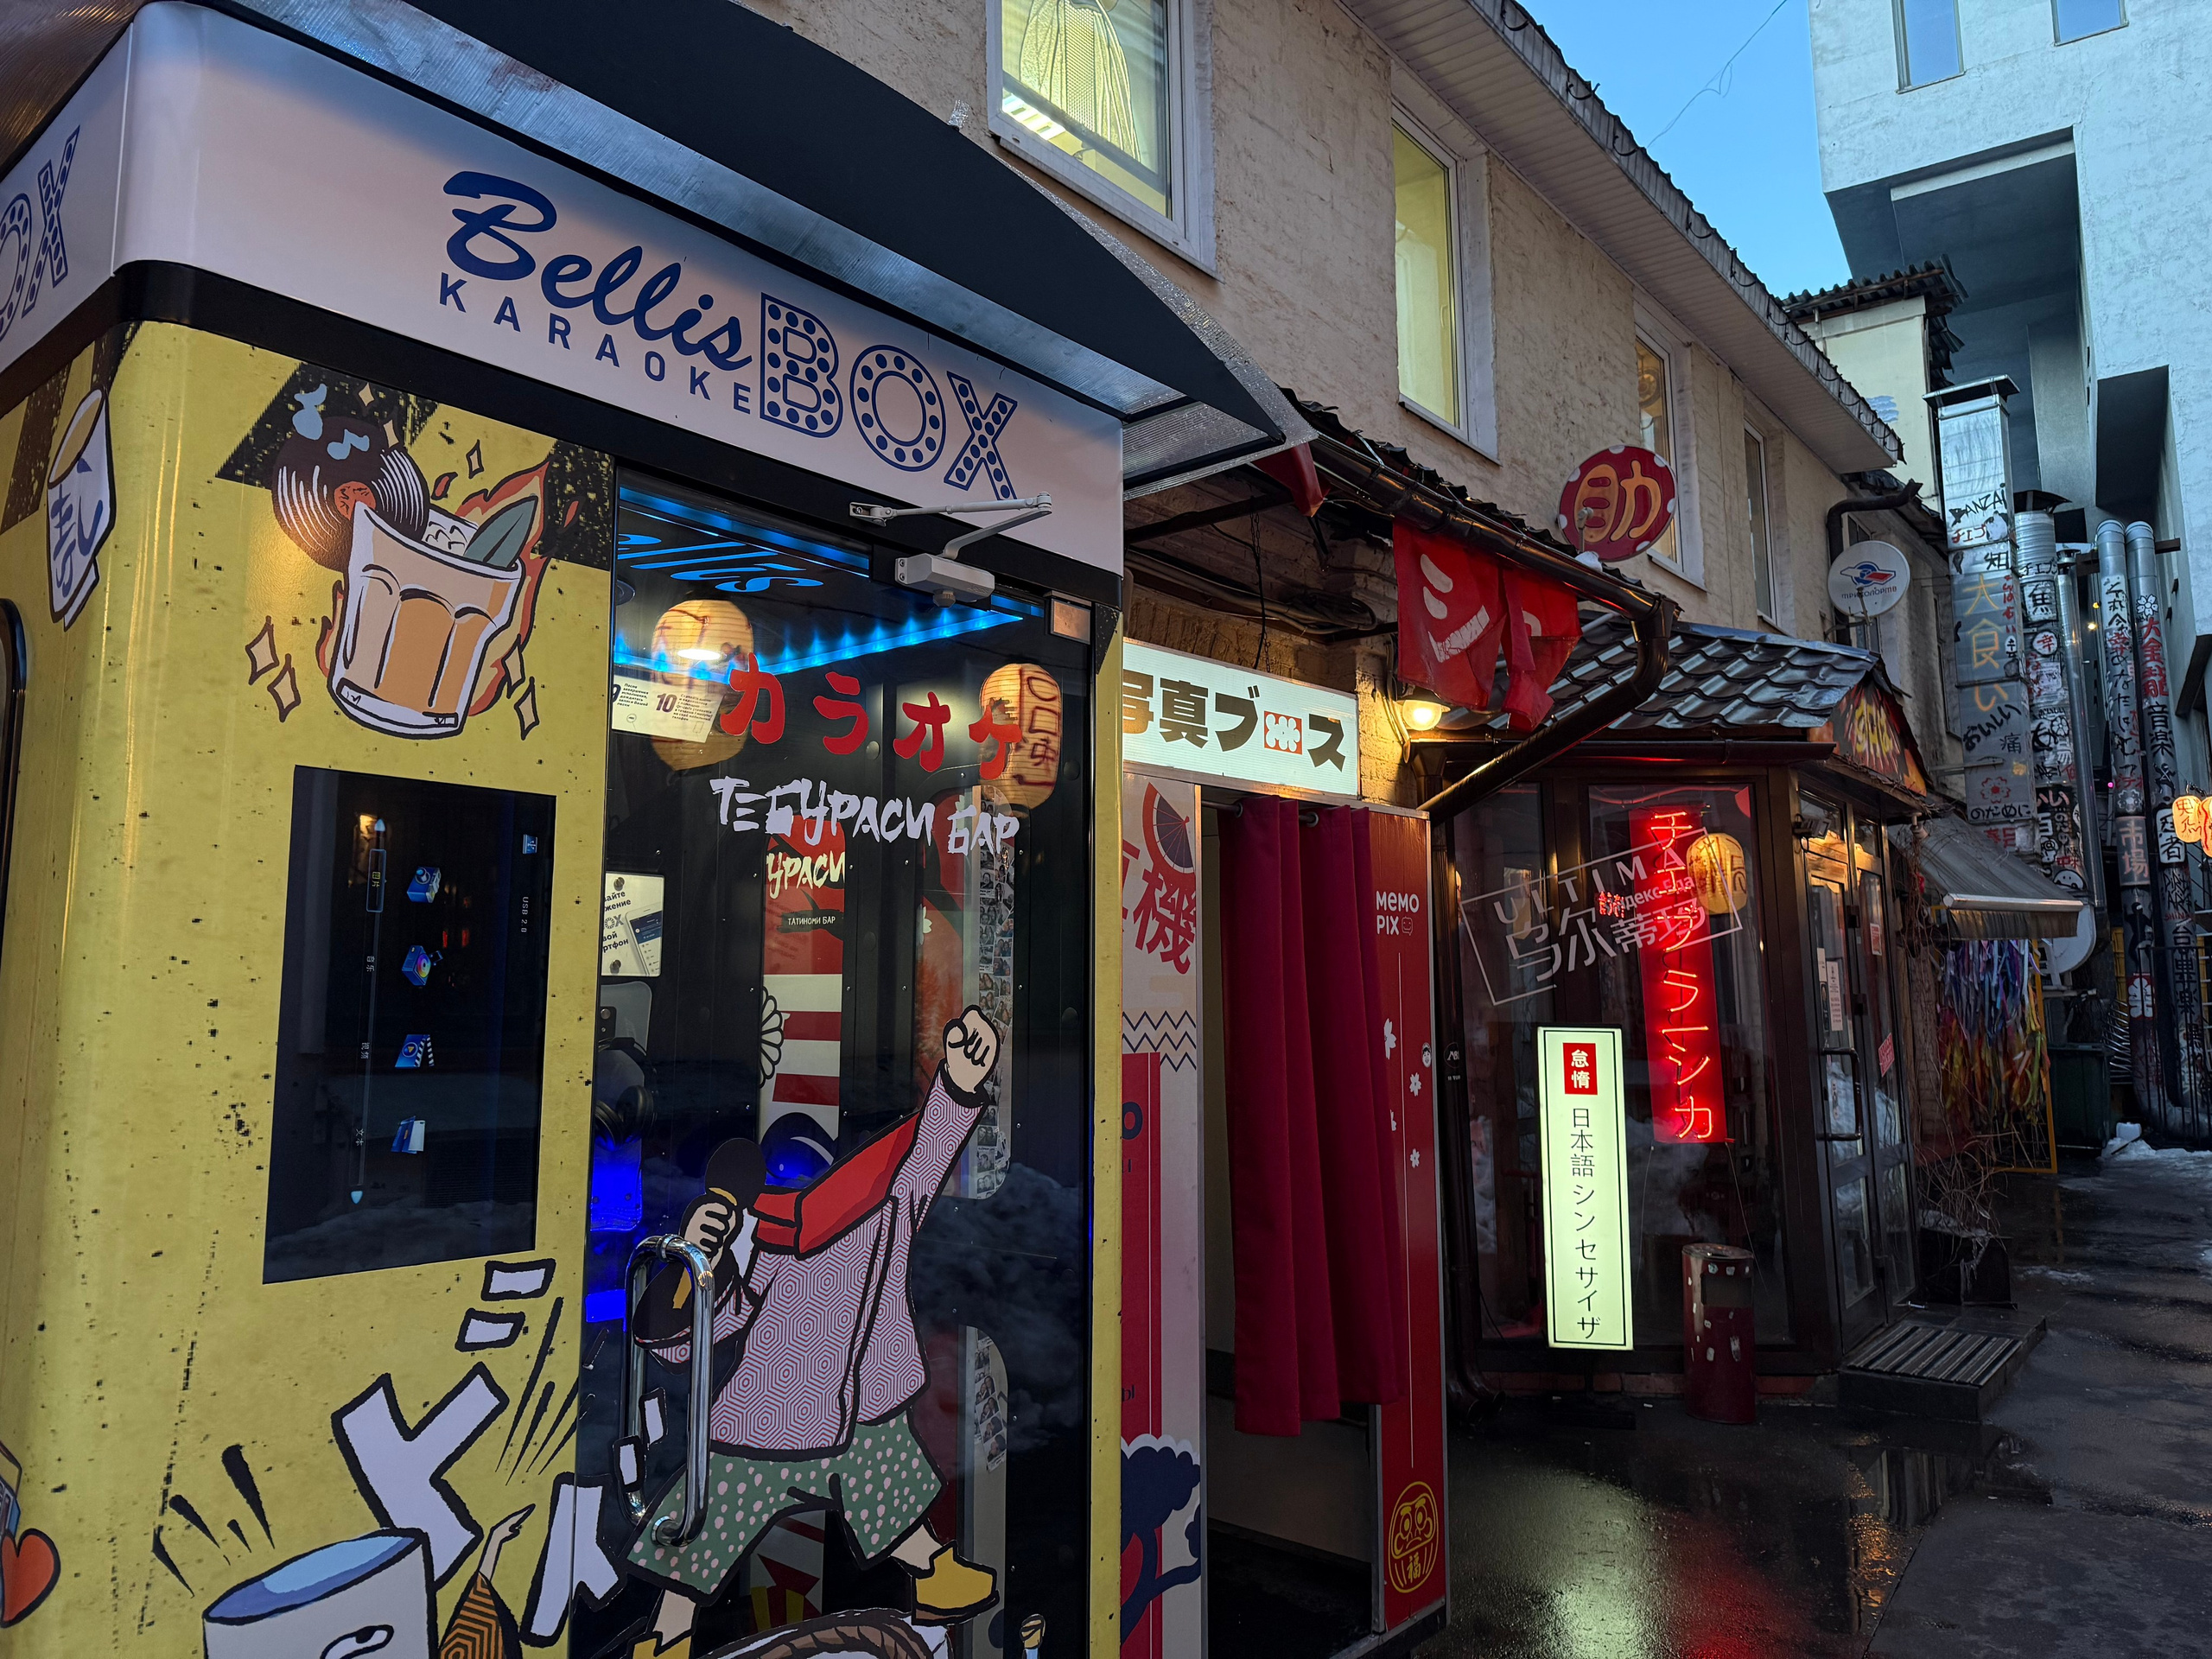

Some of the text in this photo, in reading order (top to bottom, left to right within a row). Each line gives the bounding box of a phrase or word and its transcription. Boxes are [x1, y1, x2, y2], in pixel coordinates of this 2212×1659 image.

[439, 272, 751, 416] KARAOKE
[442, 170, 1018, 501] Bellis BOX
[656, 693, 677, 713] 10
[718, 652, 1023, 779] カラオケ
[709, 776, 1020, 855] ТЕБУРАСИ БАР
[2120, 820, 2149, 878] 市場
[787, 916, 836, 925] ТАТИНОМИ БАР
[1376, 914, 1400, 936] PIX
[1493, 847, 1686, 925] ULTIMA
[1570, 1108, 1600, 1339] 日本語シンセサイザ
